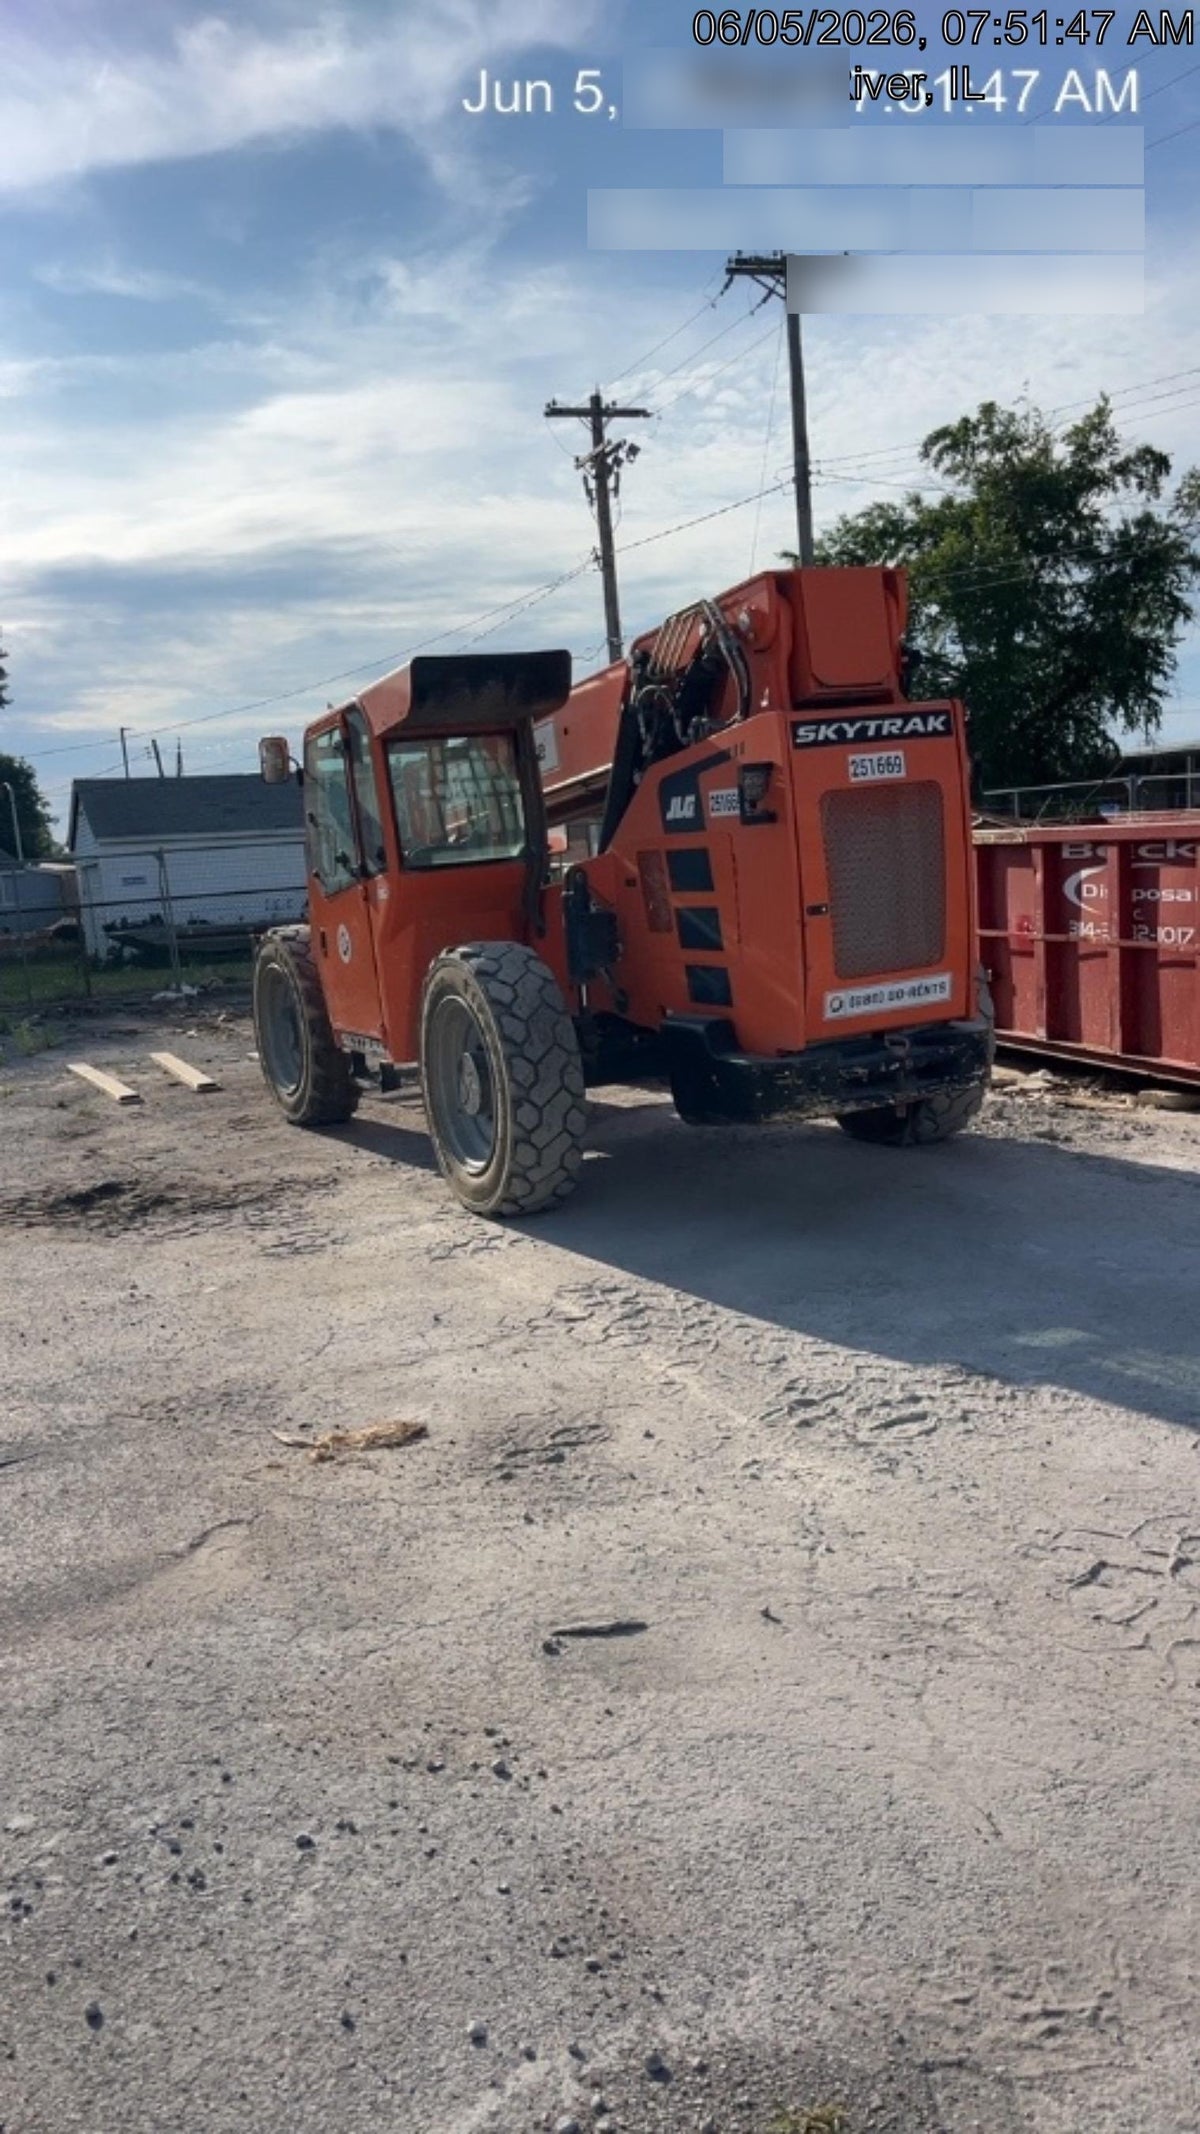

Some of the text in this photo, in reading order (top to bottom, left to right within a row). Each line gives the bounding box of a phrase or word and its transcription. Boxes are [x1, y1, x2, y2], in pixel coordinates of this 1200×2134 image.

[796, 715, 947, 743] SKYTRAK
[851, 755, 902, 778] 251669
[666, 794, 696, 820] JLG
[1082, 883, 1199, 902] Diposal
